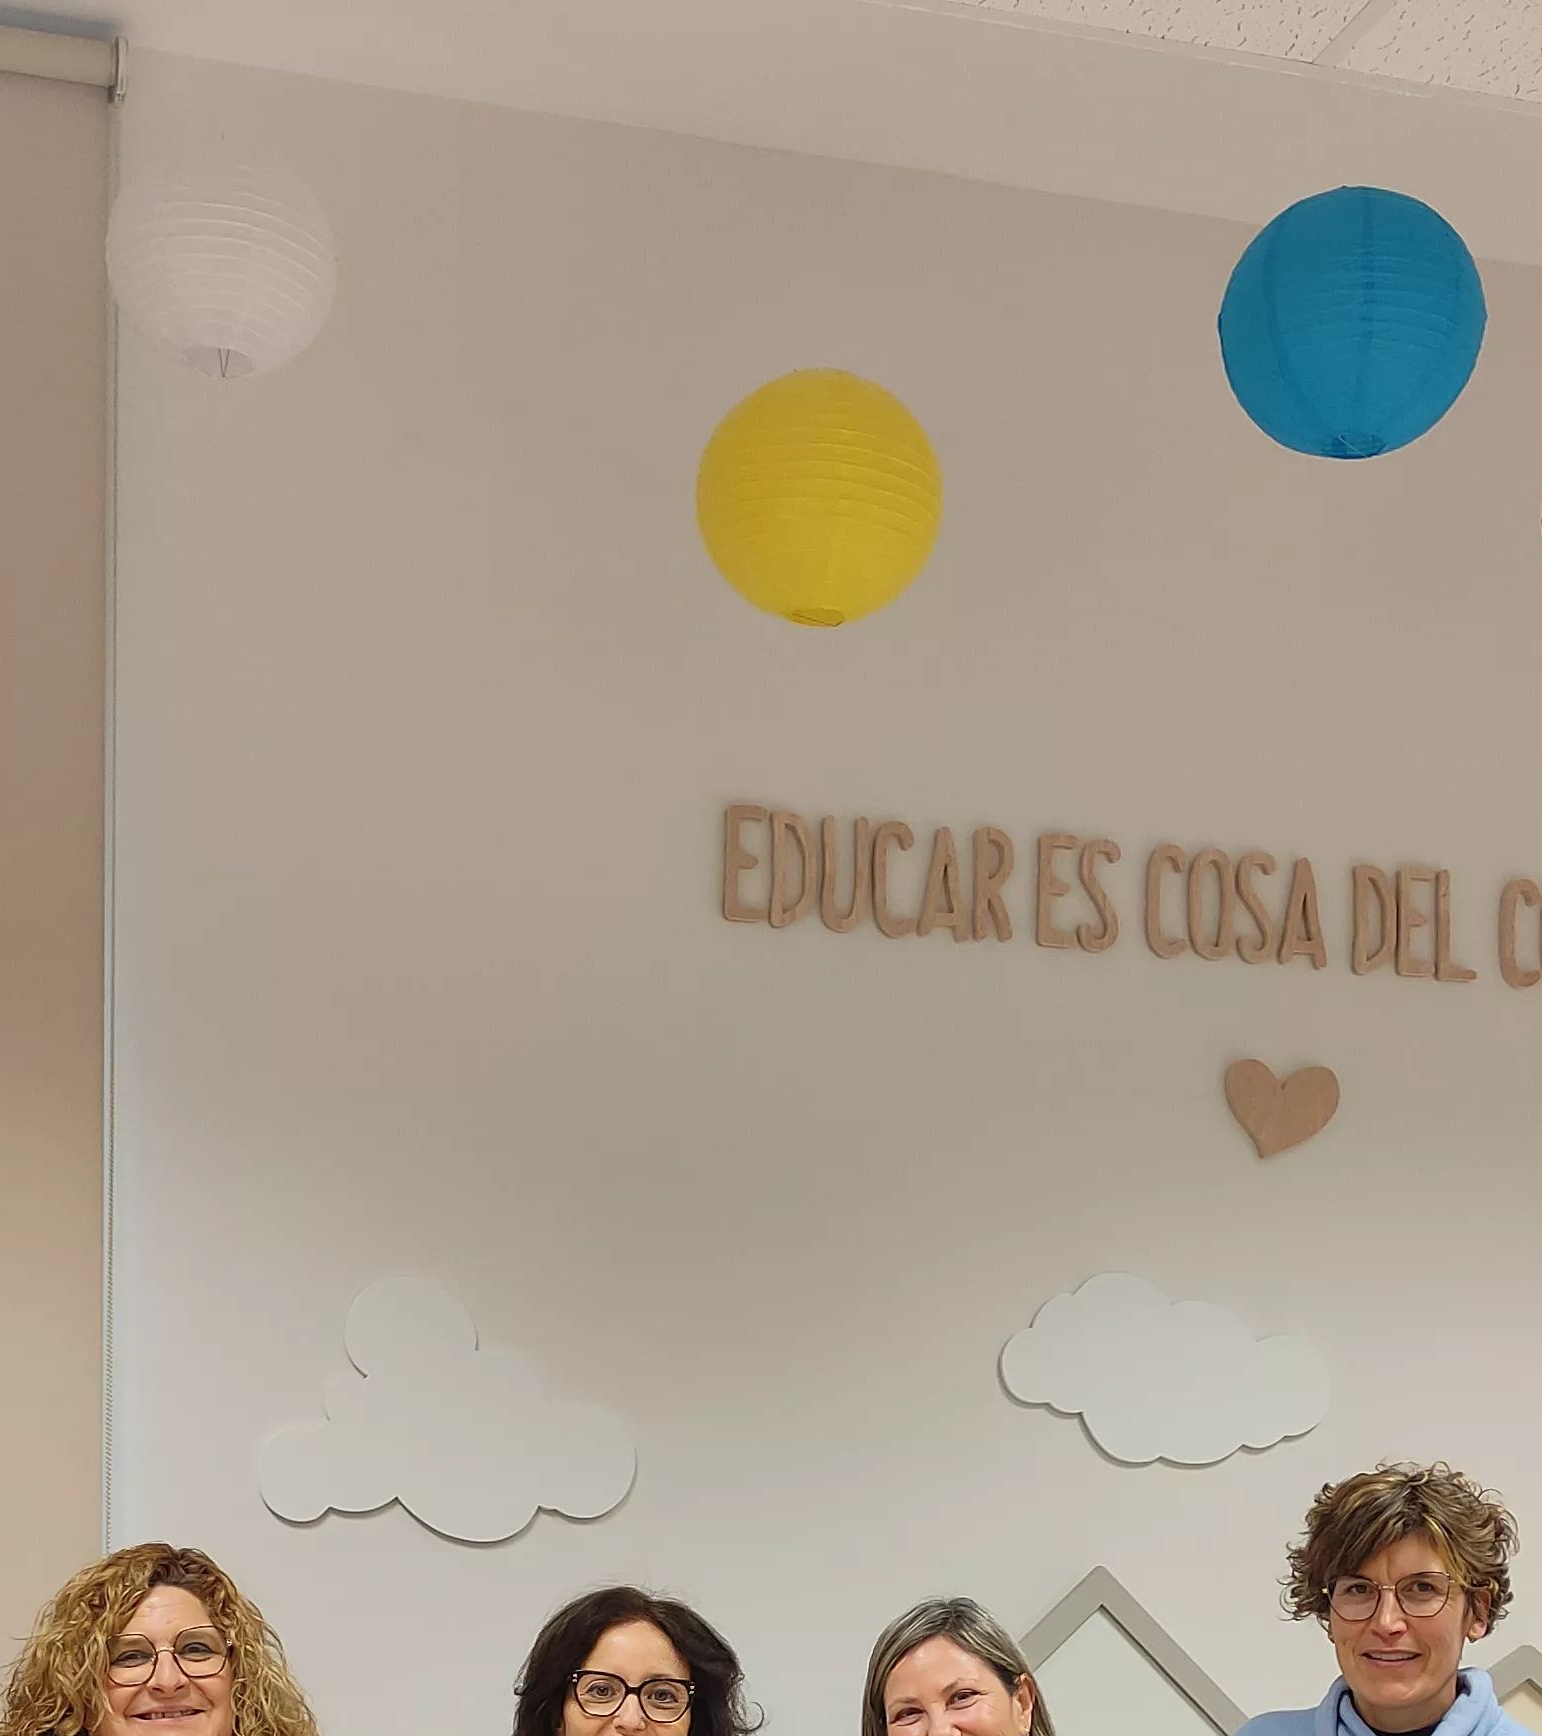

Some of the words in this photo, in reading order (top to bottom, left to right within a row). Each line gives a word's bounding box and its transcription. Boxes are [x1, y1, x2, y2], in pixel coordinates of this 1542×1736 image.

[724, 804, 1014, 943] EDUCAR
[1036, 833, 1121, 953] ES
[1145, 843, 1327, 970] COSA
[1351, 864, 1478, 982] DEL
